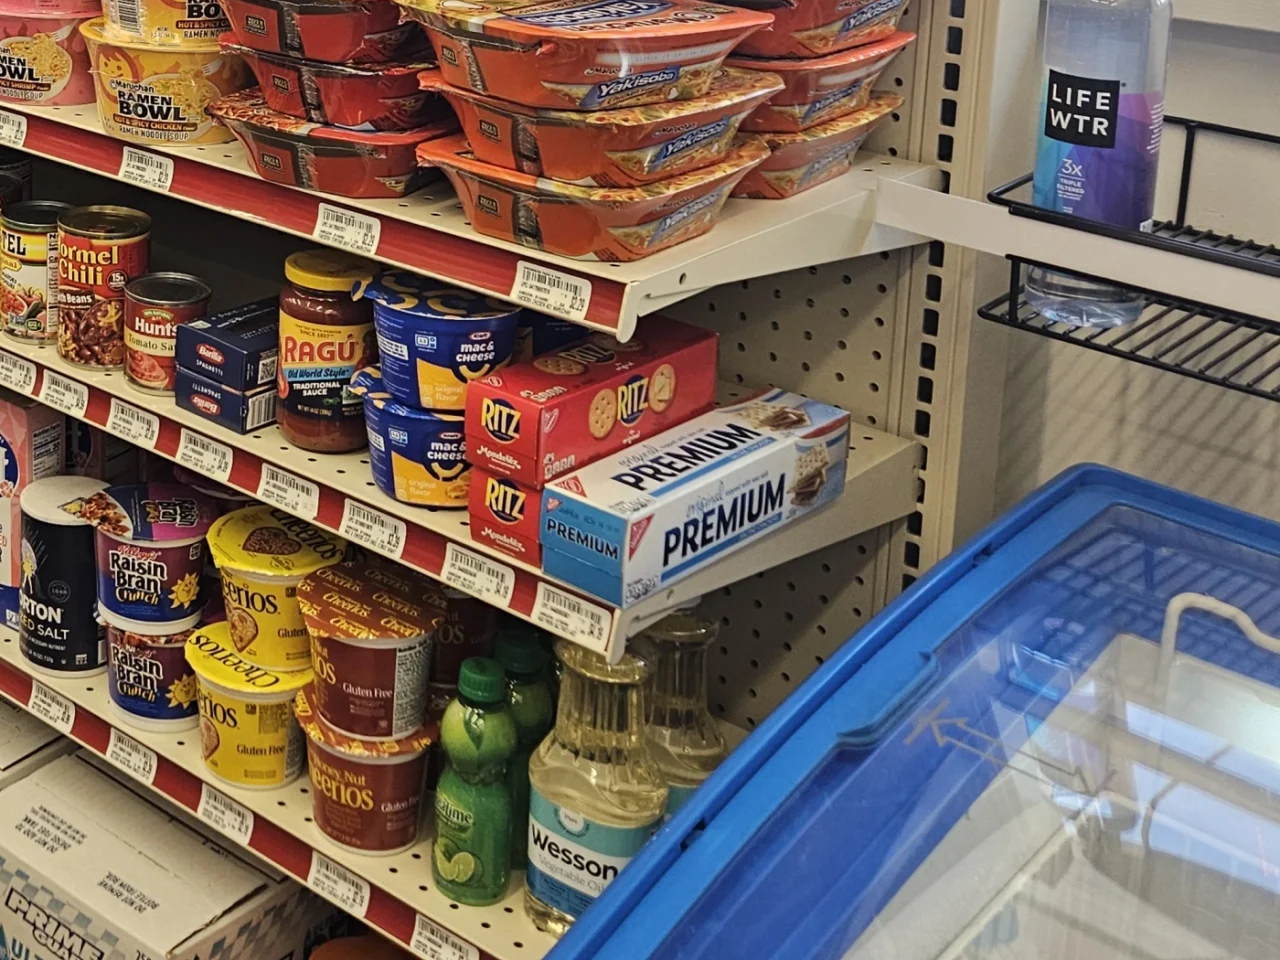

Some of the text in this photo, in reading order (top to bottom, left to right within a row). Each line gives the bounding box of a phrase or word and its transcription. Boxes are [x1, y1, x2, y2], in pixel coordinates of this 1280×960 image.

[10, 82, 37, 90] SHRIMP
[599, 71, 675, 97] Yakisoba
[117, 92, 172, 106] RAMEN
[1052, 83, 1111, 111] LIFE
[119, 100, 187, 121] BOWL
[151, 122, 183, 131] CHICKEN
[1049, 109, 1109, 137] WTR
[665, 121, 728, 155] Yakisoba
[1061, 158, 1083, 176] 3x
[59, 260, 103, 285] Chili
[66, 294, 92, 303] Beans
[127, 334, 158, 351] Tomato
[285, 334, 355, 363] RAGÚ
[196, 359, 224, 377] SPAGHETTI
[288, 368, 348, 378] Old World Style
[192, 383, 221, 399] SPAGHETTI
[293, 382, 341, 390] TRADITIONAL
[303, 388, 327, 396] SAUCE
[435, 385, 464, 394] original
[435, 392, 458, 401] flavor
[618, 377, 650, 425] RITZ
[480, 398, 522, 445] RITZ
[611, 423, 762, 491] PREMIUM
[484, 478, 525, 522] RITZ
[662, 473, 785, 567] PREMIUM
[546, 518, 619, 561] PREMIUM
[109, 551, 166, 580] Raisin
[115, 569, 160, 594] Bran
[116, 588, 160, 605] Crunch
[37, 625, 69, 640] SALT
[278, 627, 308, 639] Gluten
[111, 643, 163, 678] Raisin
[189, 633, 280, 688] Cheerios
[116, 663, 157, 691] Bran
[342, 682, 393, 699] Gluten Free
[237, 743, 286, 755] Gluten Free
[343, 770, 367, 786] Nut
[531, 825, 619, 880] Wesson
[539, 854, 584, 887] Vegetable
